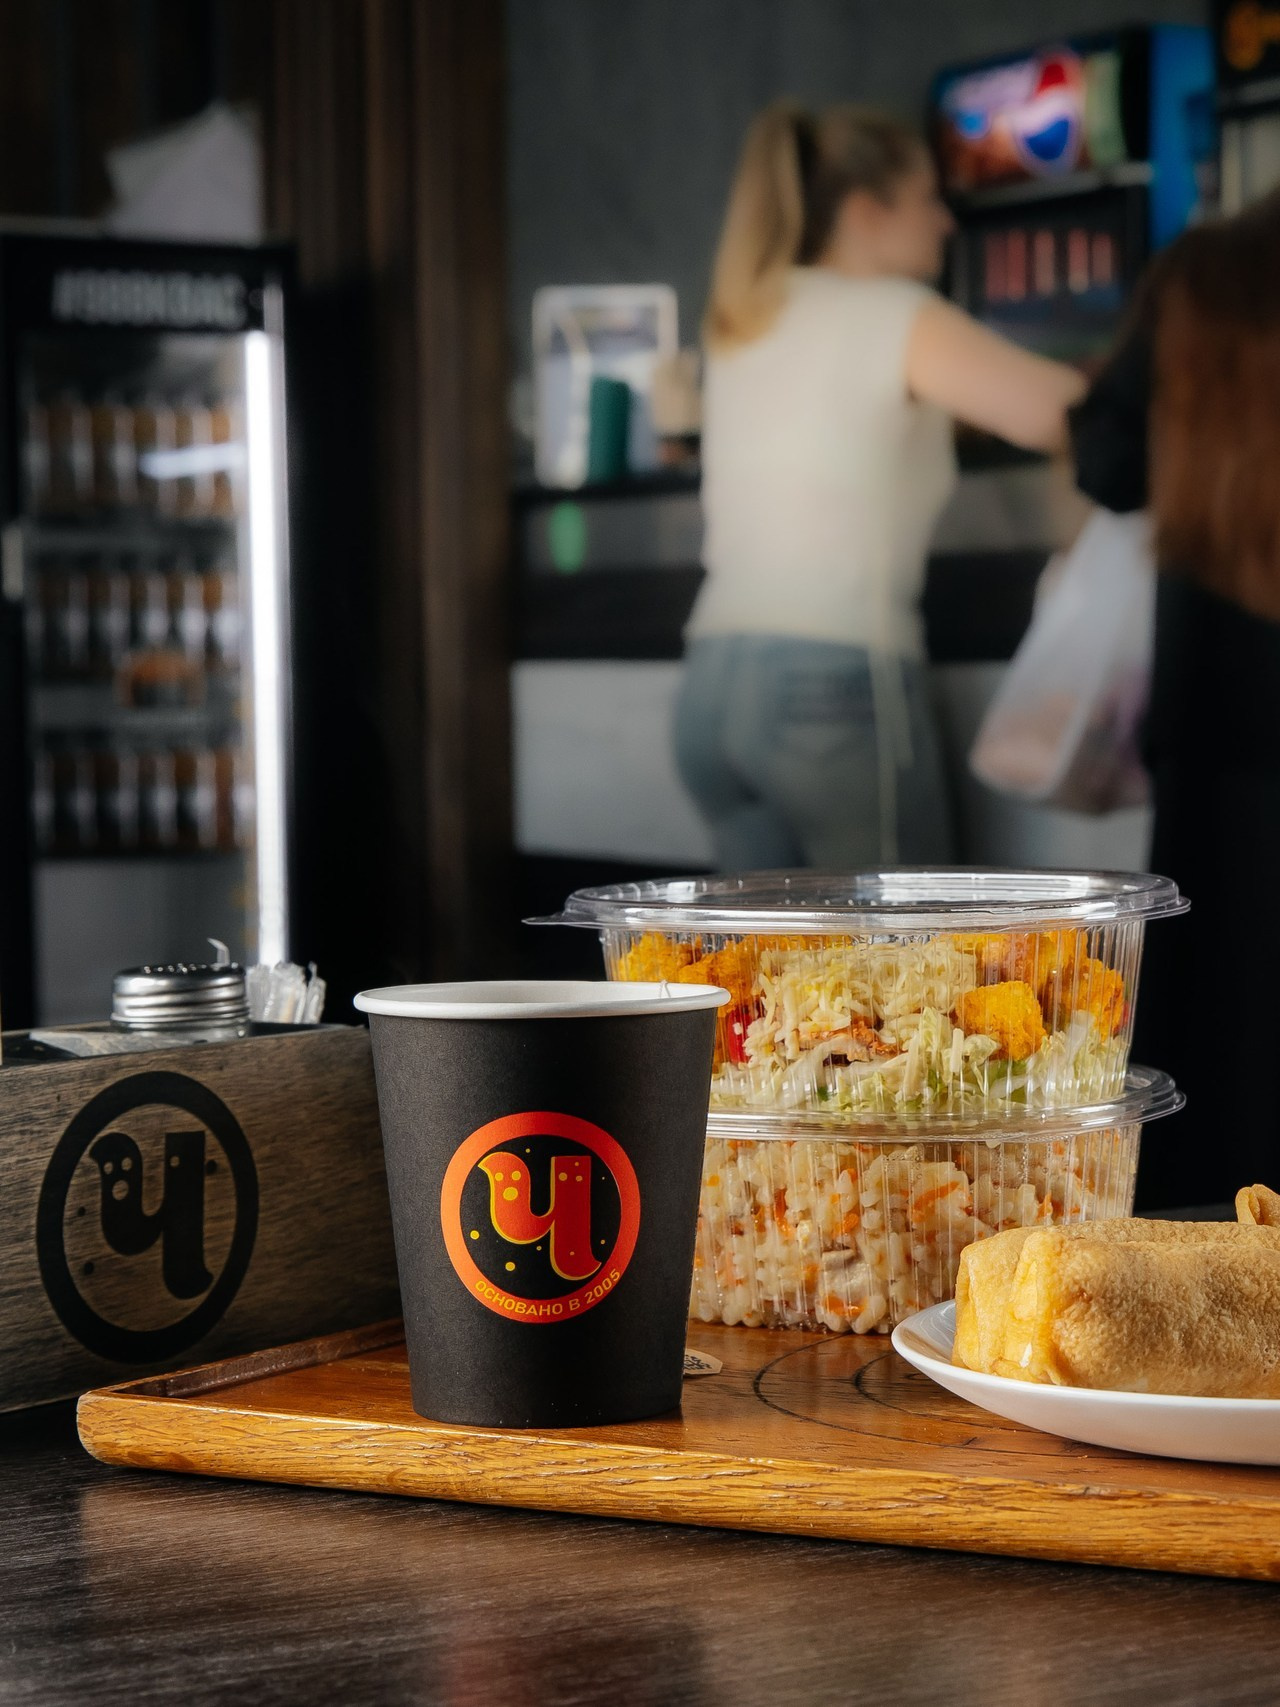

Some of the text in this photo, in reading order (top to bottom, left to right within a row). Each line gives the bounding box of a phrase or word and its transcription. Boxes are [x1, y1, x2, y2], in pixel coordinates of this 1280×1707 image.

[475, 1268, 620, 1316] ОСНОВАНО В 2005
